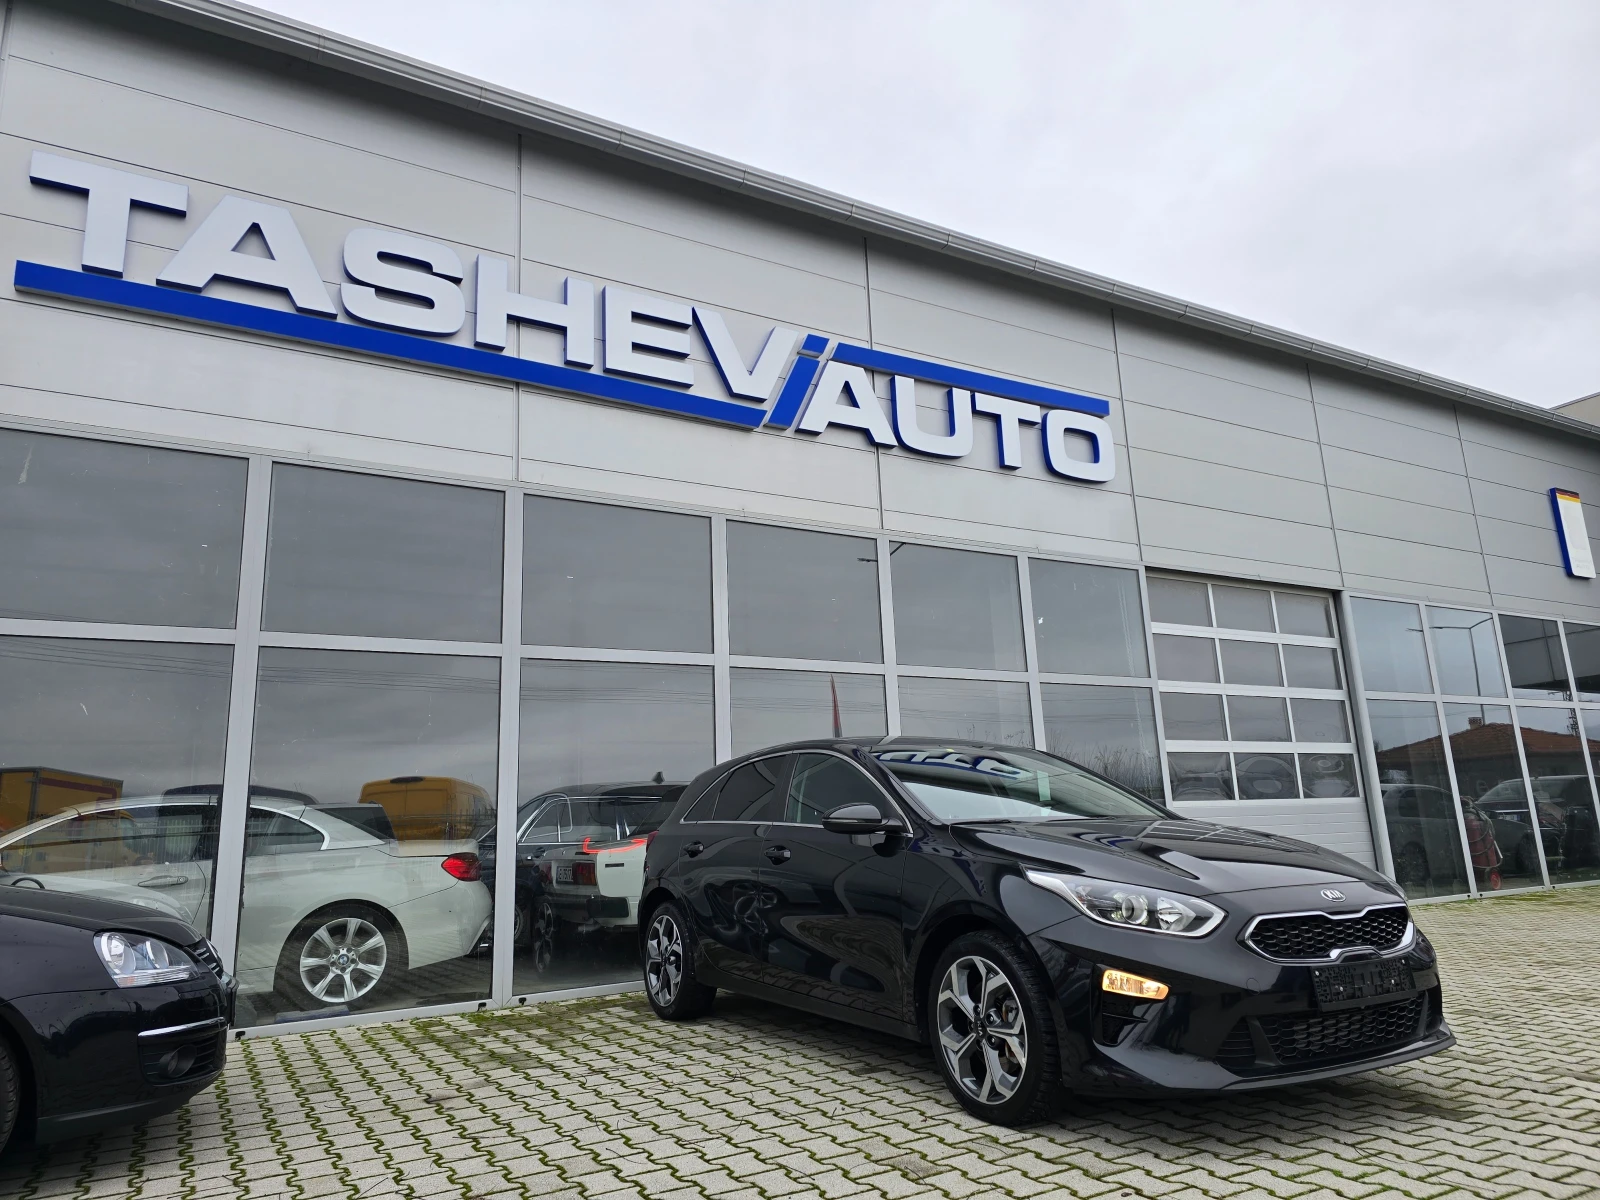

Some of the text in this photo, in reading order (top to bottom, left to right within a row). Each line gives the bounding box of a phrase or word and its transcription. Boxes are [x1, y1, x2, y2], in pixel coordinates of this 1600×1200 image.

[29, 150, 799, 403] TASHEV
[795, 360, 1116, 482] AUTO
[1322, 889, 1344, 899] KIA
